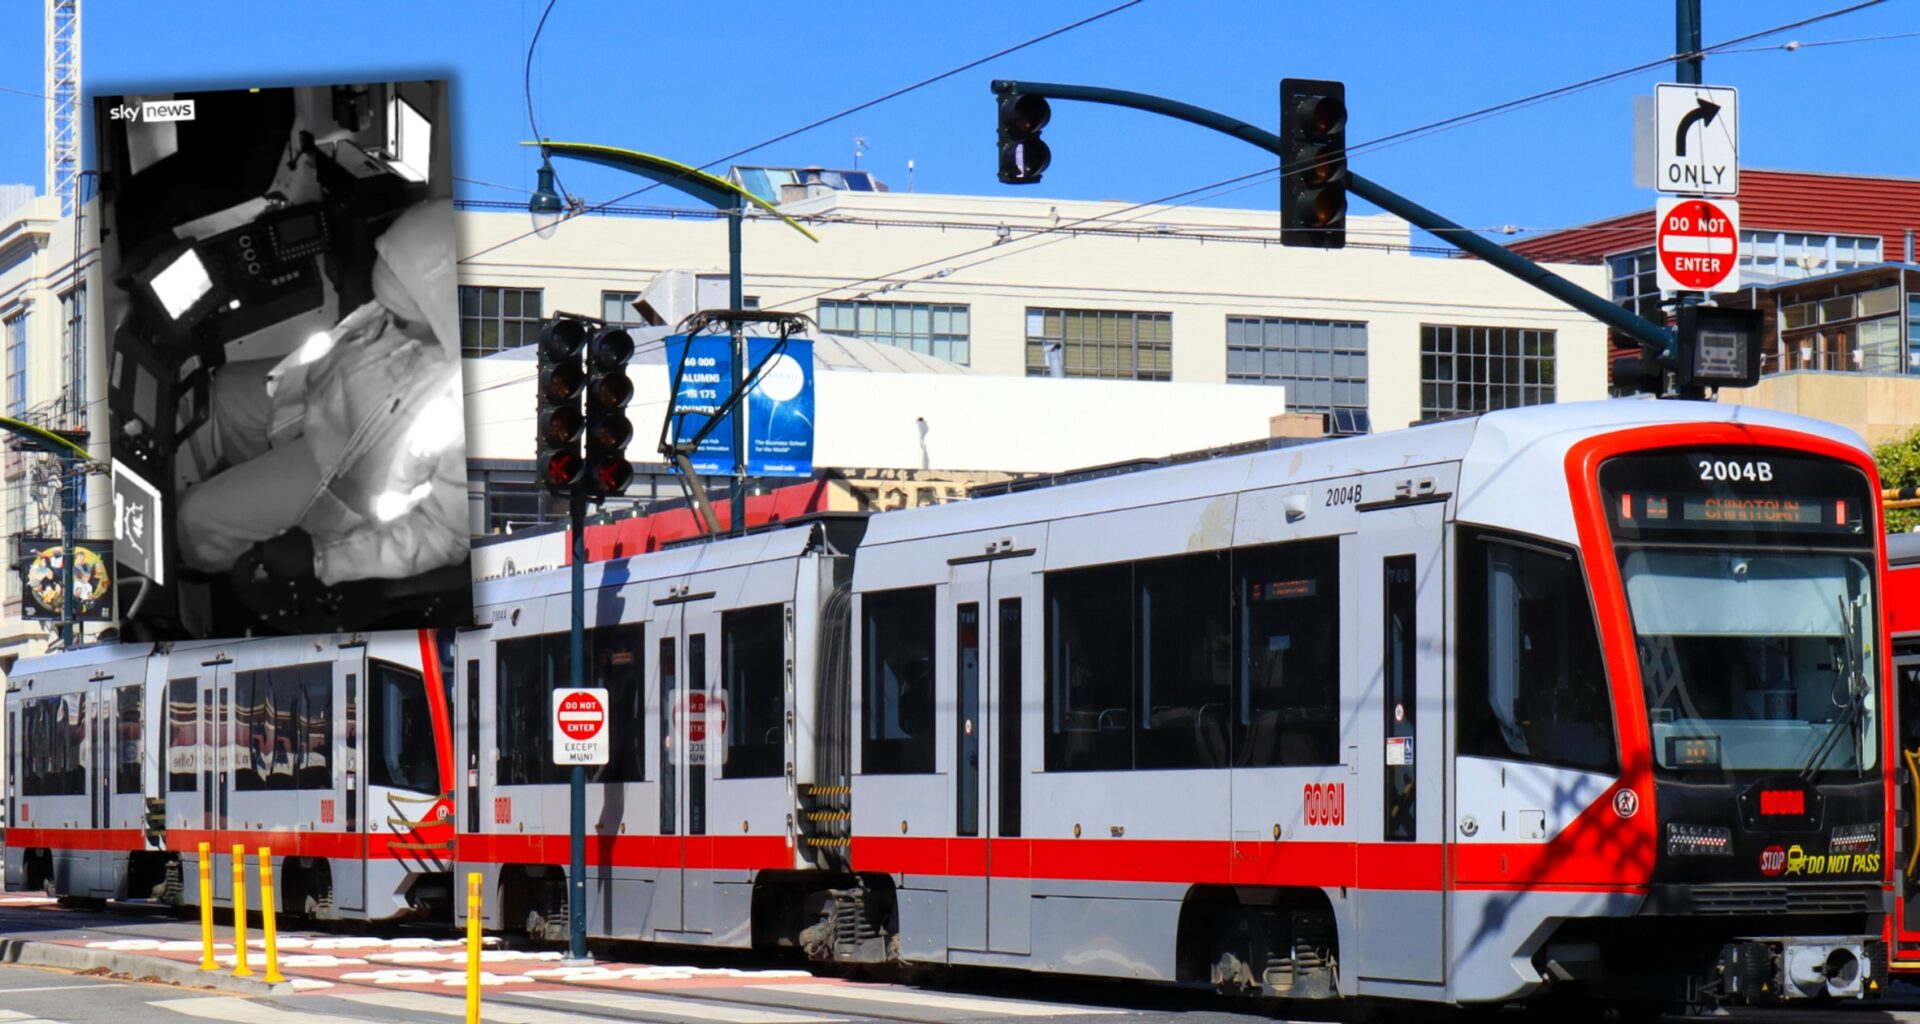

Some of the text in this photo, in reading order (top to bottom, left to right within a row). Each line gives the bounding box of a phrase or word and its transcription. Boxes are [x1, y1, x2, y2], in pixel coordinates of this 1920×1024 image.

[1668, 163, 1726, 185] ONLY
[1669, 216, 1726, 233] DO NOT
[1675, 256, 1721, 273] ENTER
[681, 373, 720, 383] ALUMNI
[699, 389, 717, 399] 175
[1699, 461, 1773, 482] 2004B
[1325, 484, 1362, 507] 2004B
[565, 701, 596, 710] DO NOT
[567, 723, 595, 732] ENTER
[564, 742, 598, 751] EXCEPT
[570, 752, 594, 761] MUNI
[1761, 851, 1786, 871] STOP
[1807, 853, 1881, 874] DO NOT PASS
